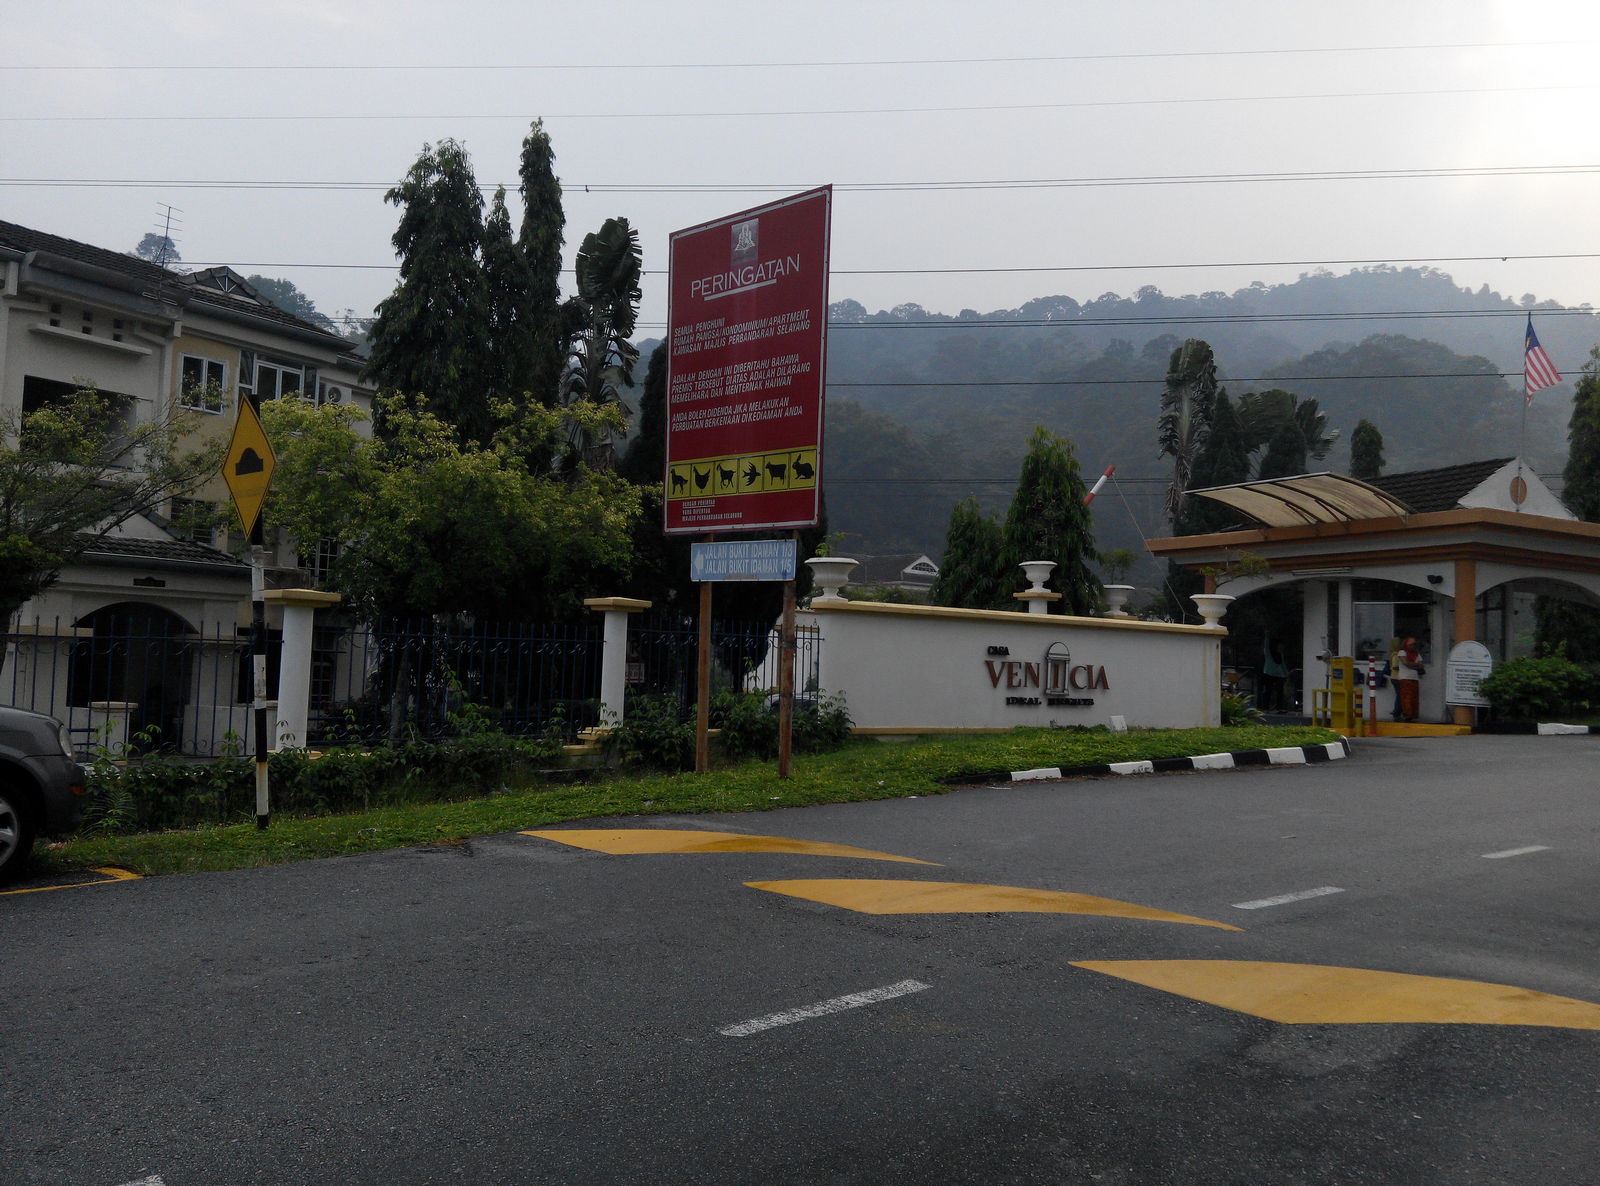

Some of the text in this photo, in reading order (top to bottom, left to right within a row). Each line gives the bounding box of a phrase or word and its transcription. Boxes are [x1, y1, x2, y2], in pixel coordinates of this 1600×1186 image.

[691, 253, 800, 298] PERINGATAN
[673, 320, 810, 355] KAWASAN MAJLIS PERBANDARAN SELAYANG
[674, 317, 726, 336] SEMUA PENGHUNI
[673, 334, 694, 346] RUMAH
[671, 382, 693, 394] PREMIS
[694, 377, 724, 391] TERSEBUT
[749, 367, 776, 381] ADALAH
[776, 362, 811, 377] DILARANG
[672, 353, 799, 384] ADALAH DENGAN INI DIBERITAHU BAHAWA
[671, 376, 792, 404] MEMELIHARA DAN MENTERNAK HAIWAN
[671, 397, 789, 422] ANDA BOLEH DIDENDA JIKA MELAKUKAN
[671, 418, 704, 432] PERBUATAN
[704, 414, 741, 428] BERKENAAN
[784, 406, 803, 417] ANDA
[704, 542, 793, 560] JALAN BUKIT IDAMAN 1/3
[704, 558, 792, 574] JALAN BUKIT IDAMAN 1/5
[987, 646, 1010, 656] CASA
[984, 659, 1110, 690] VENICIA
